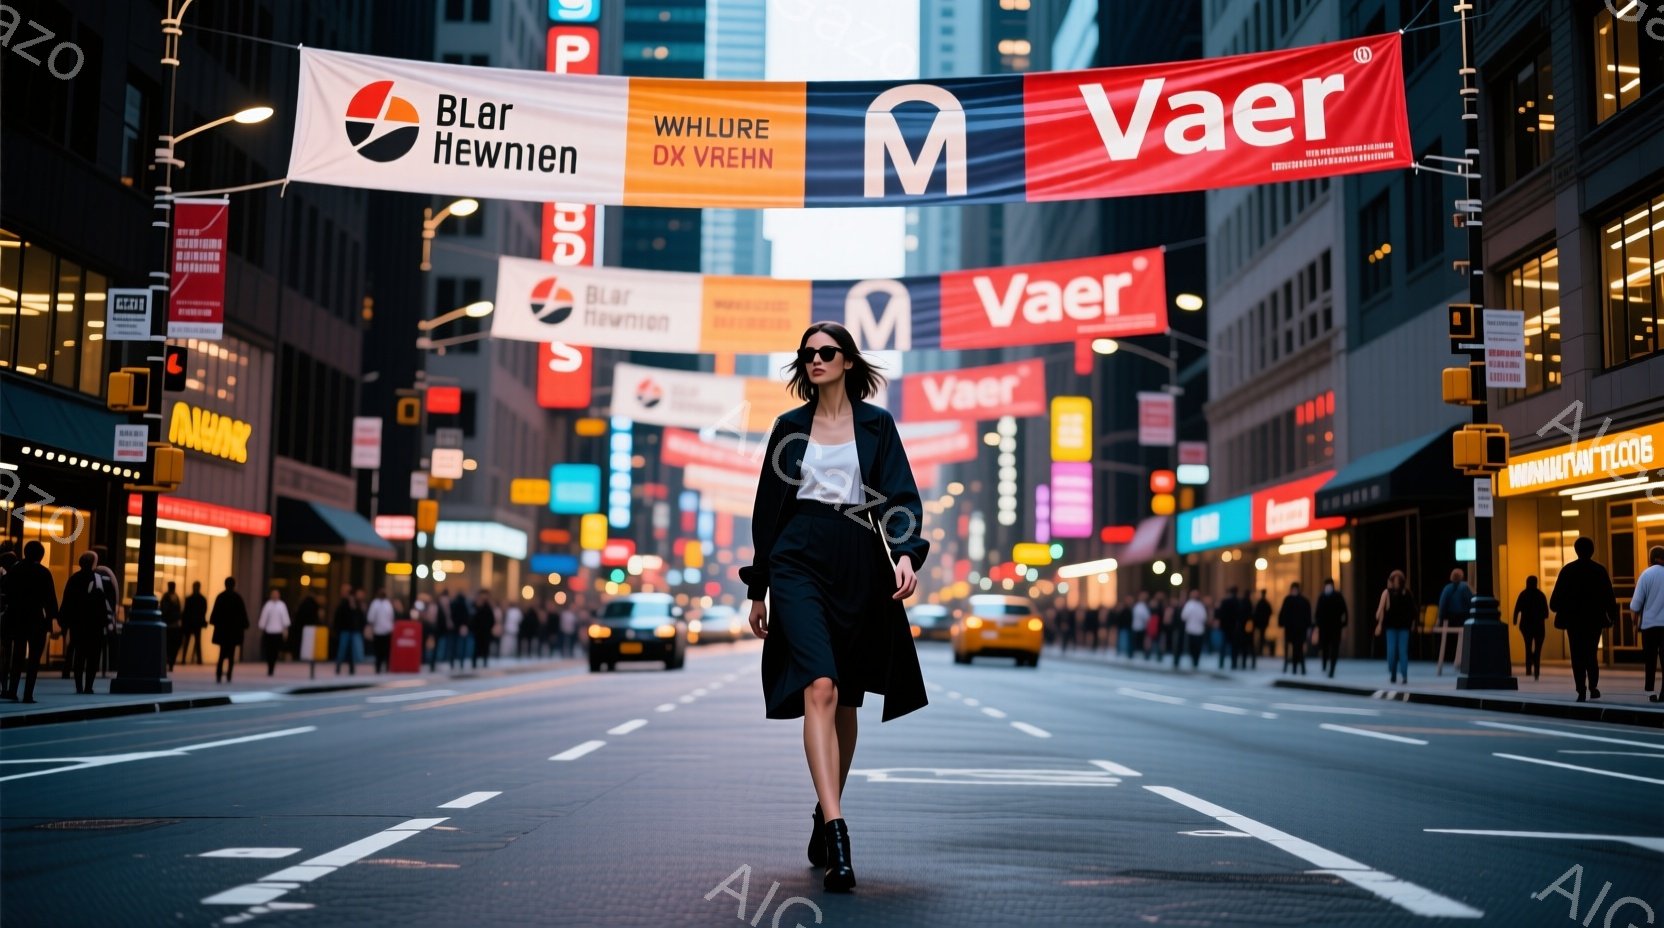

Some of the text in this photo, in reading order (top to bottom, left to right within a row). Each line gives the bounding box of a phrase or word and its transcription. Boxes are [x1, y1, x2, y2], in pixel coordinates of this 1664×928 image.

[864, 84, 967, 198] M
[1078, 73, 1345, 161] Vaer
[653, 144, 773, 169] DX VREHN
[973, 272, 1133, 328] Vaer
[921, 373, 1020, 413] Vaer
